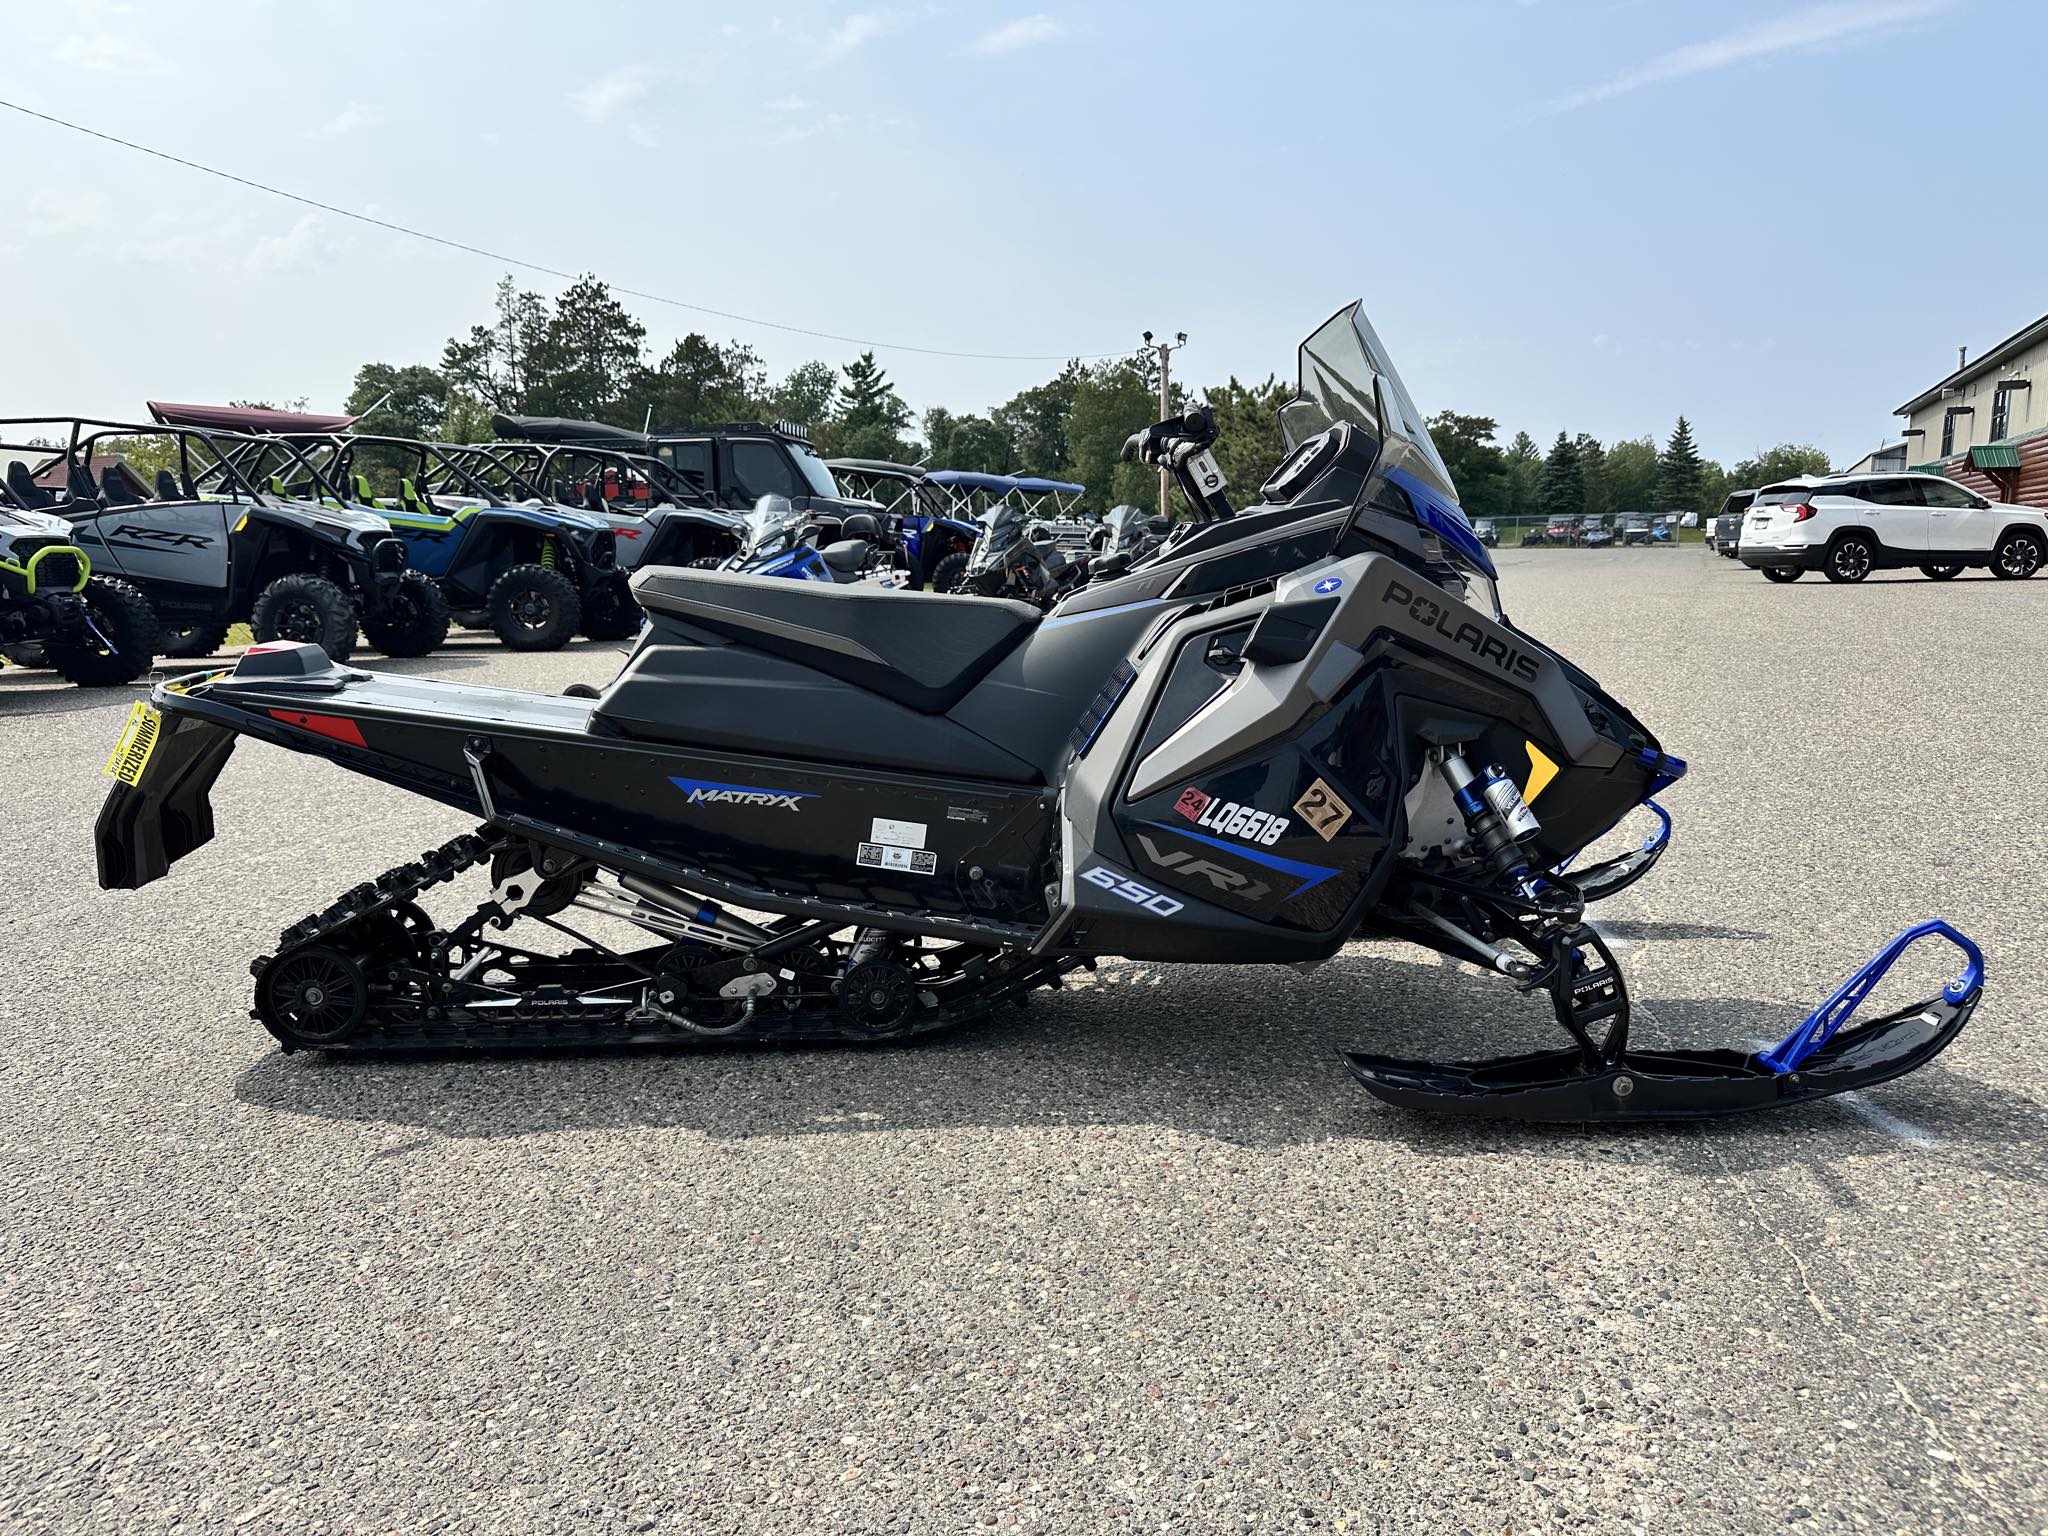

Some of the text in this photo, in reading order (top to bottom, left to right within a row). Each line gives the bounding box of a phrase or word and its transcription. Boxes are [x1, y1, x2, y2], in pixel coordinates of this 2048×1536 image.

[109, 525, 215, 549] RZR
[1382, 580, 1540, 683] POLARIS
[118, 715, 157, 782] SUMMERIZED
[686, 788, 803, 812] MATRYX
[1180, 790, 1204, 812] 24
[1197, 797, 1290, 846] LQ6618
[1298, 788, 1345, 830] 27
[1136, 833, 1273, 901] VR1
[1078, 866, 1185, 917] 650
[1573, 977, 1614, 995] POLARIS
